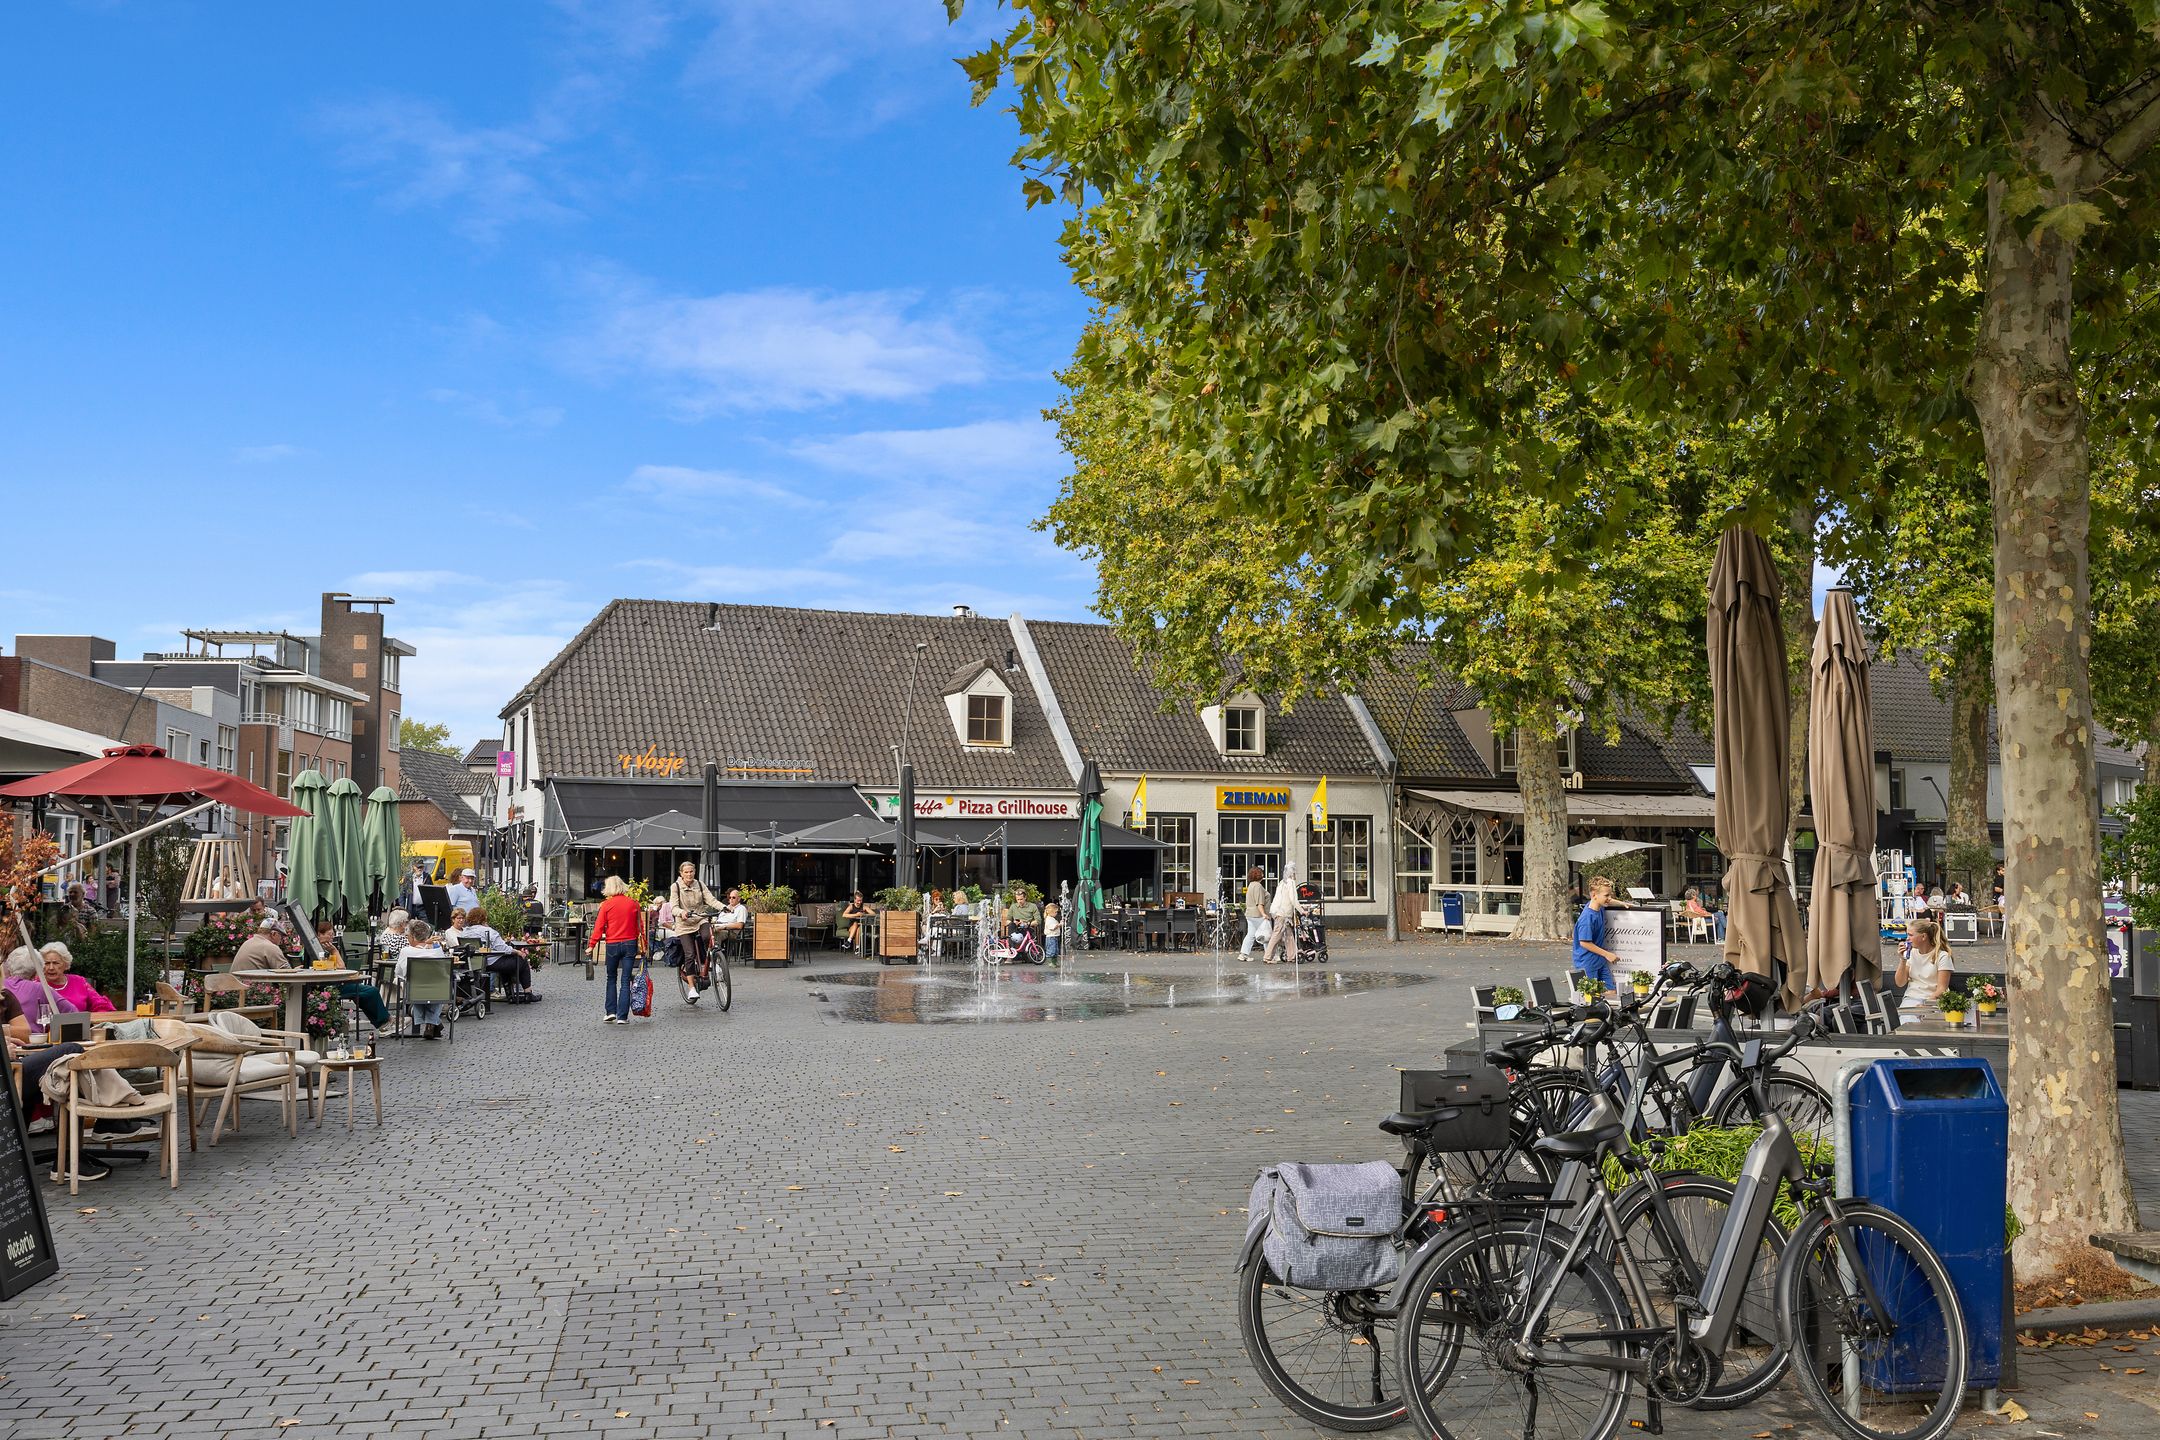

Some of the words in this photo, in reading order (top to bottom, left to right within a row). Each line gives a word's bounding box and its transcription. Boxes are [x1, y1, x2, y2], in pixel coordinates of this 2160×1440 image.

[617, 754, 632, 769] 't
[635, 744, 685, 777] Vosje
[727, 757, 744, 766] De
[1223, 791, 1287, 805] ZEEMAN
[914, 799, 943, 814] affa
[959, 800, 993, 814] Pizza
[998, 799, 1068, 815] Grillhouse
[1604, 926, 1654, 939] ppuccino
[7, 1230, 36, 1260] victoria
